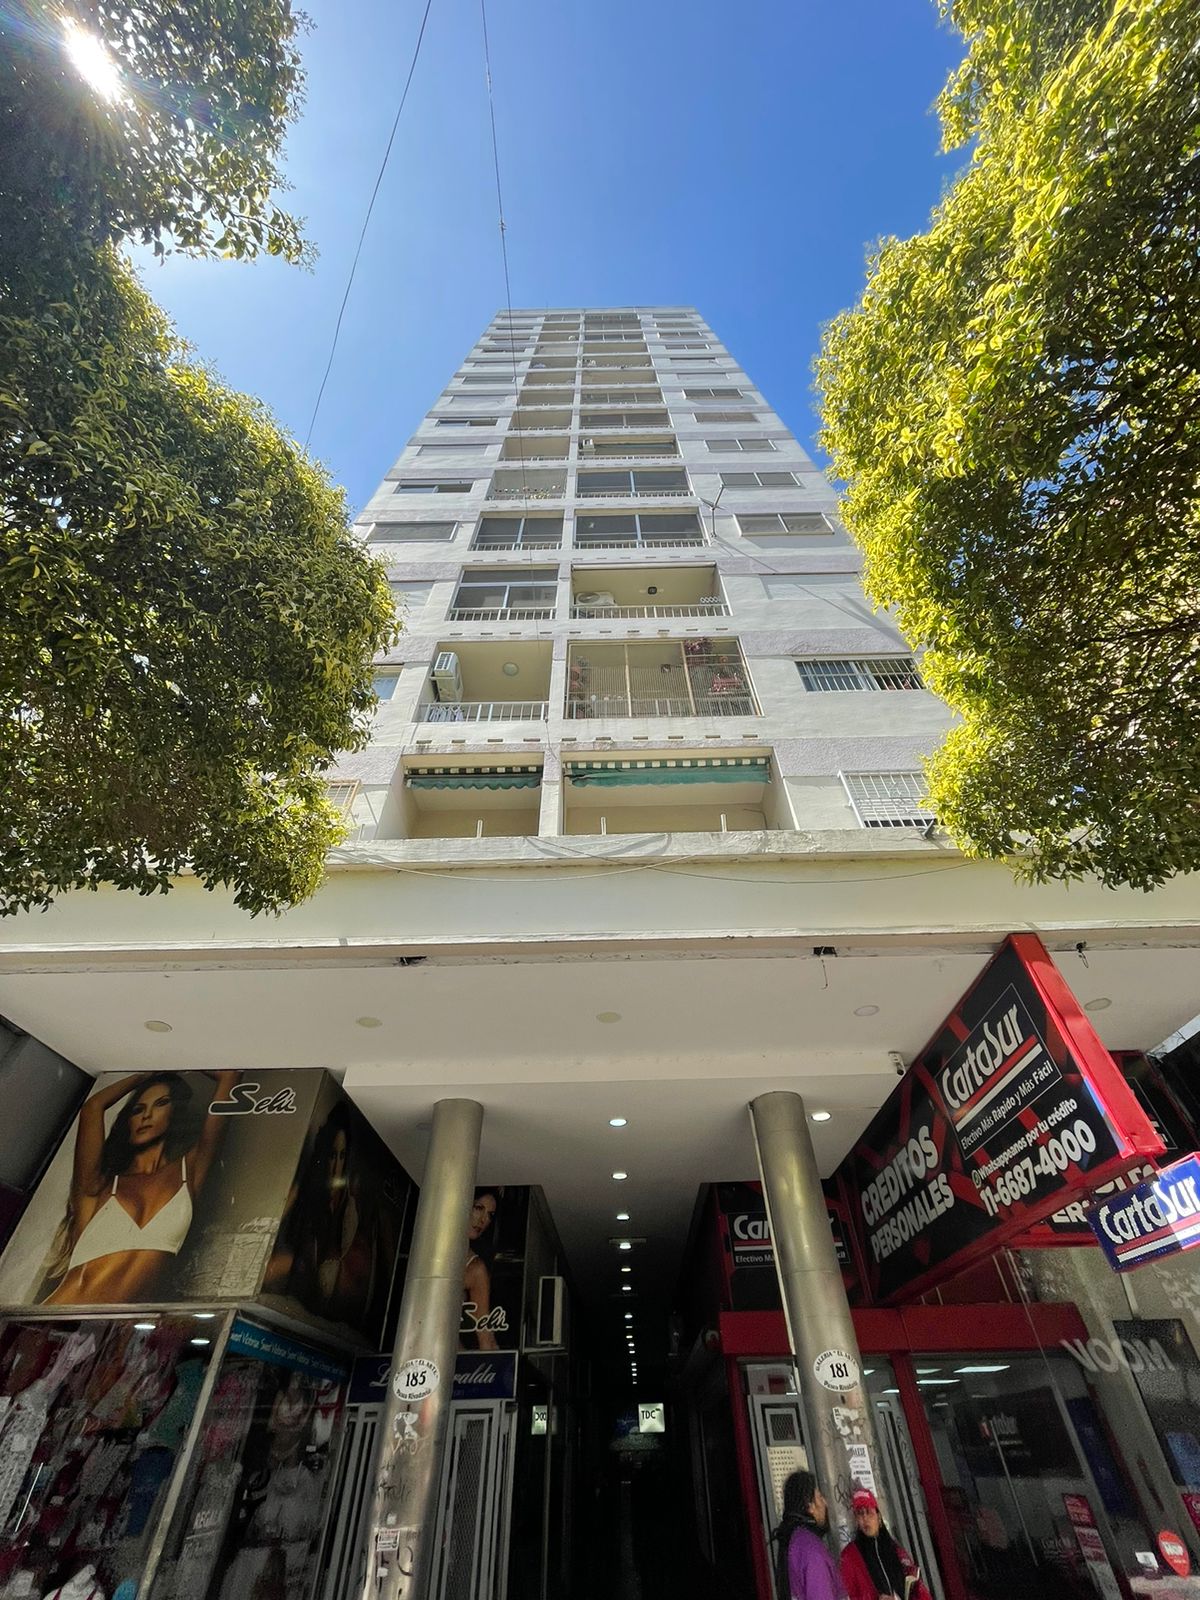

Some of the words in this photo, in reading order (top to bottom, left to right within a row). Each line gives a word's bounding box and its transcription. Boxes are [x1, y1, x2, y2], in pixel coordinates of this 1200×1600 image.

[942, 1003, 1024, 1109] CartaSur
[961, 1125, 983, 1150] Efectivo
[992, 1095, 1016, 1122] Rápido
[1014, 1091, 1022, 1105] y
[978, 1136, 1028, 1180] Whatsappeanos
[1025, 1128, 1040, 1148] por
[1039, 1122, 1049, 1136] tu
[1047, 1097, 1078, 1127] crédito
[860, 1125, 939, 1226] CREDITOS
[980, 1119, 1097, 1217] 11-6687-4000
[871, 1172, 955, 1263] PERSONALES
[1099, 1175, 1200, 1245] CartaSur
[406, 1370, 427, 1387] 185
[829, 1362, 849, 1378] 181
[640, 1408, 656, 1420] TDC
